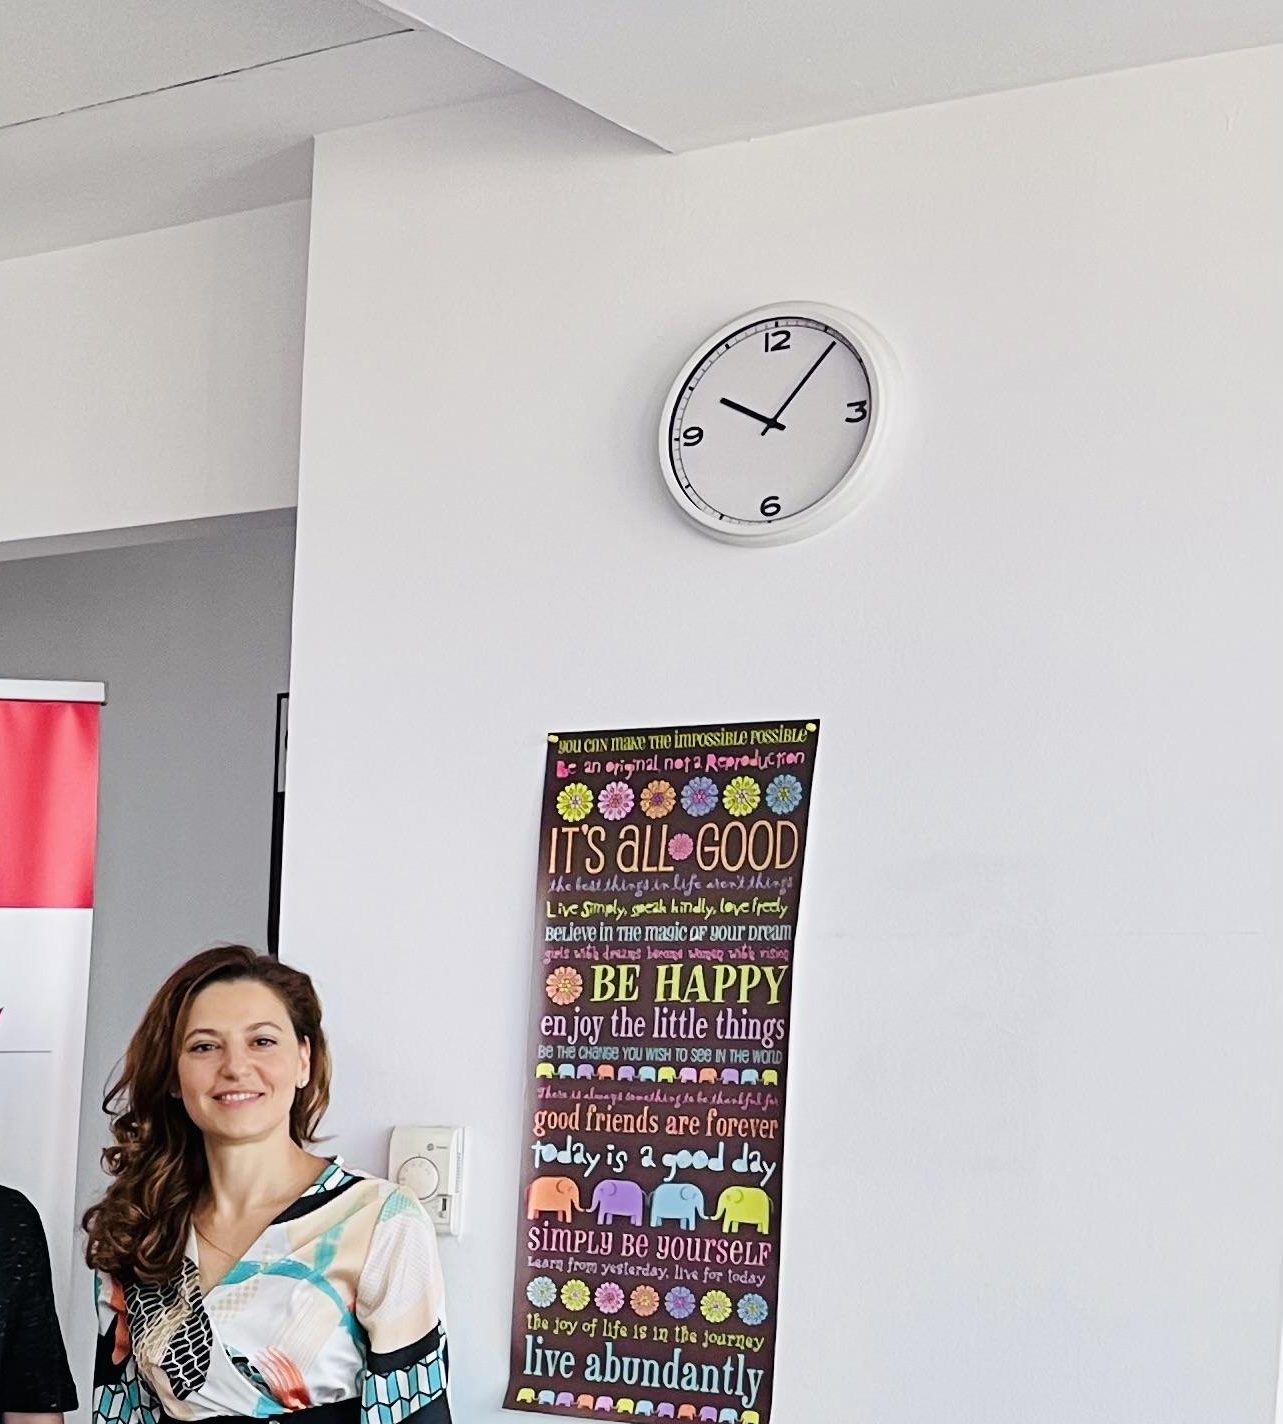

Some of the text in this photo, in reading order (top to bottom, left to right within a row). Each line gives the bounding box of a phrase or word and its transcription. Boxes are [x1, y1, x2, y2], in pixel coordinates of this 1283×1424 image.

[764, 330, 791, 352] 12
[845, 400, 867, 423] 3
[683, 426, 704, 447] 9
[760, 495, 781, 517] 6
[556, 761, 577, 778] Be
[584, 761, 601, 774] an
[694, 756, 702, 769] a
[548, 823, 606, 874] IT'S
[696, 820, 799, 871] GOOD
[546, 900, 579, 918] Live
[720, 897, 750, 916] love
[590, 964, 788, 1005] BE HAPPY
[541, 1007, 785, 1049] enjoy the little things
[533, 1104, 778, 1139] good friends are forever
[532, 1136, 777, 1186] today is a good day
[702, 1267, 723, 1283] for
[728, 1268, 766, 1288] today
[526, 1312, 765, 1353] the joy of life is in the journey
[523, 1335, 764, 1409] live abundantly
